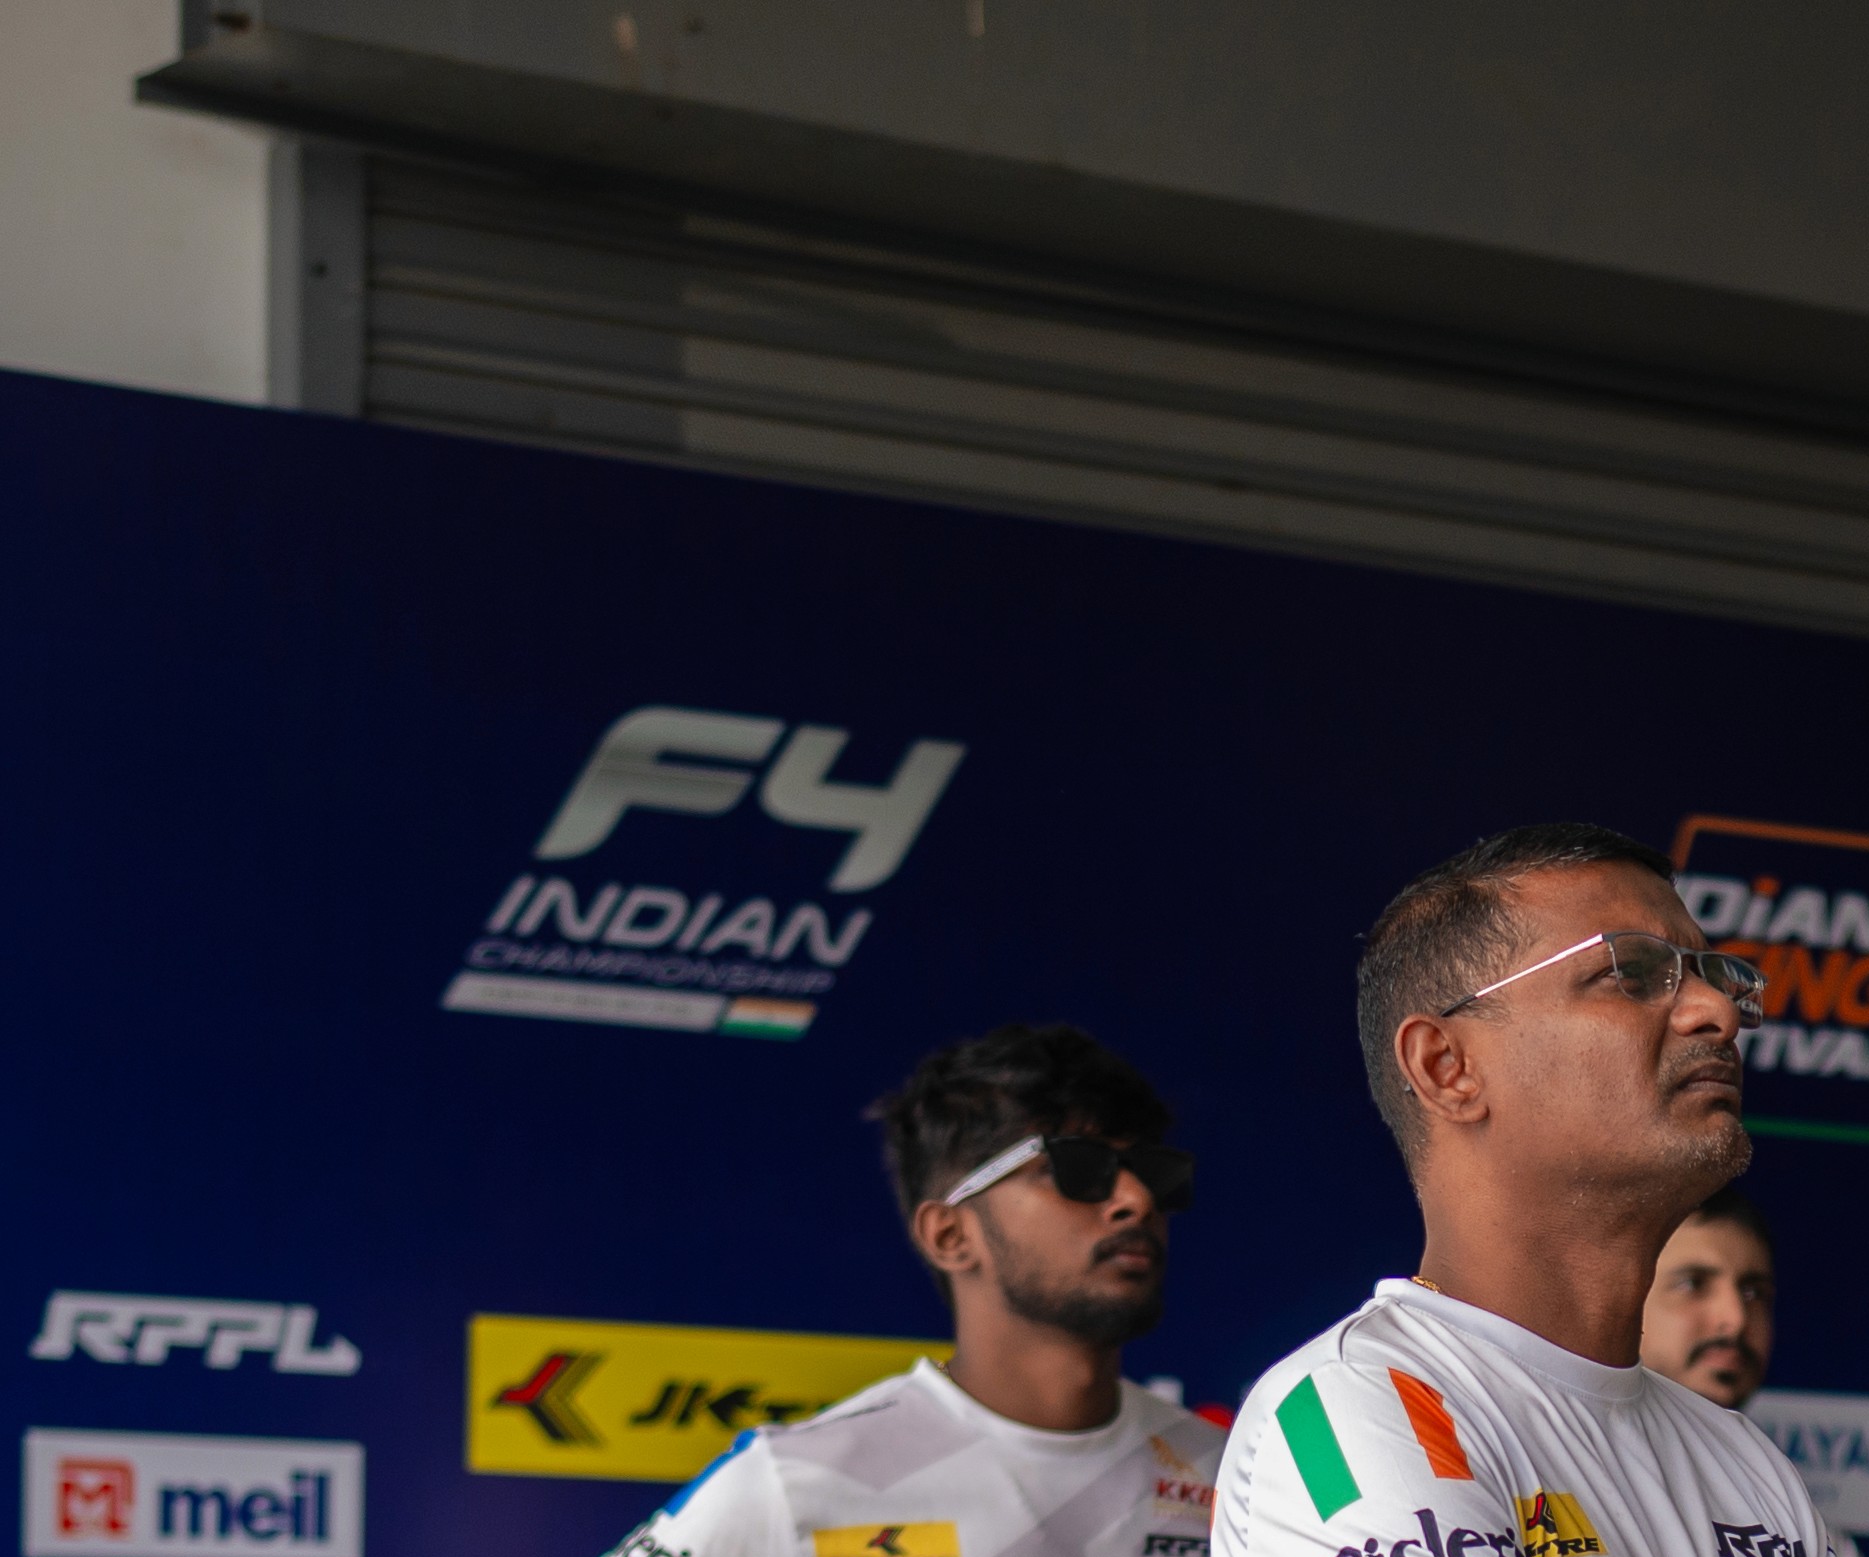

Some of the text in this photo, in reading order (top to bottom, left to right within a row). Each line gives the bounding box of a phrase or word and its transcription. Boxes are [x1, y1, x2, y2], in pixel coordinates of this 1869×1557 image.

[534, 705, 966, 892] F4
[487, 874, 872, 967] INDIAN
[28, 1290, 362, 1376] RPPL
[159, 1469, 331, 1542] meil
